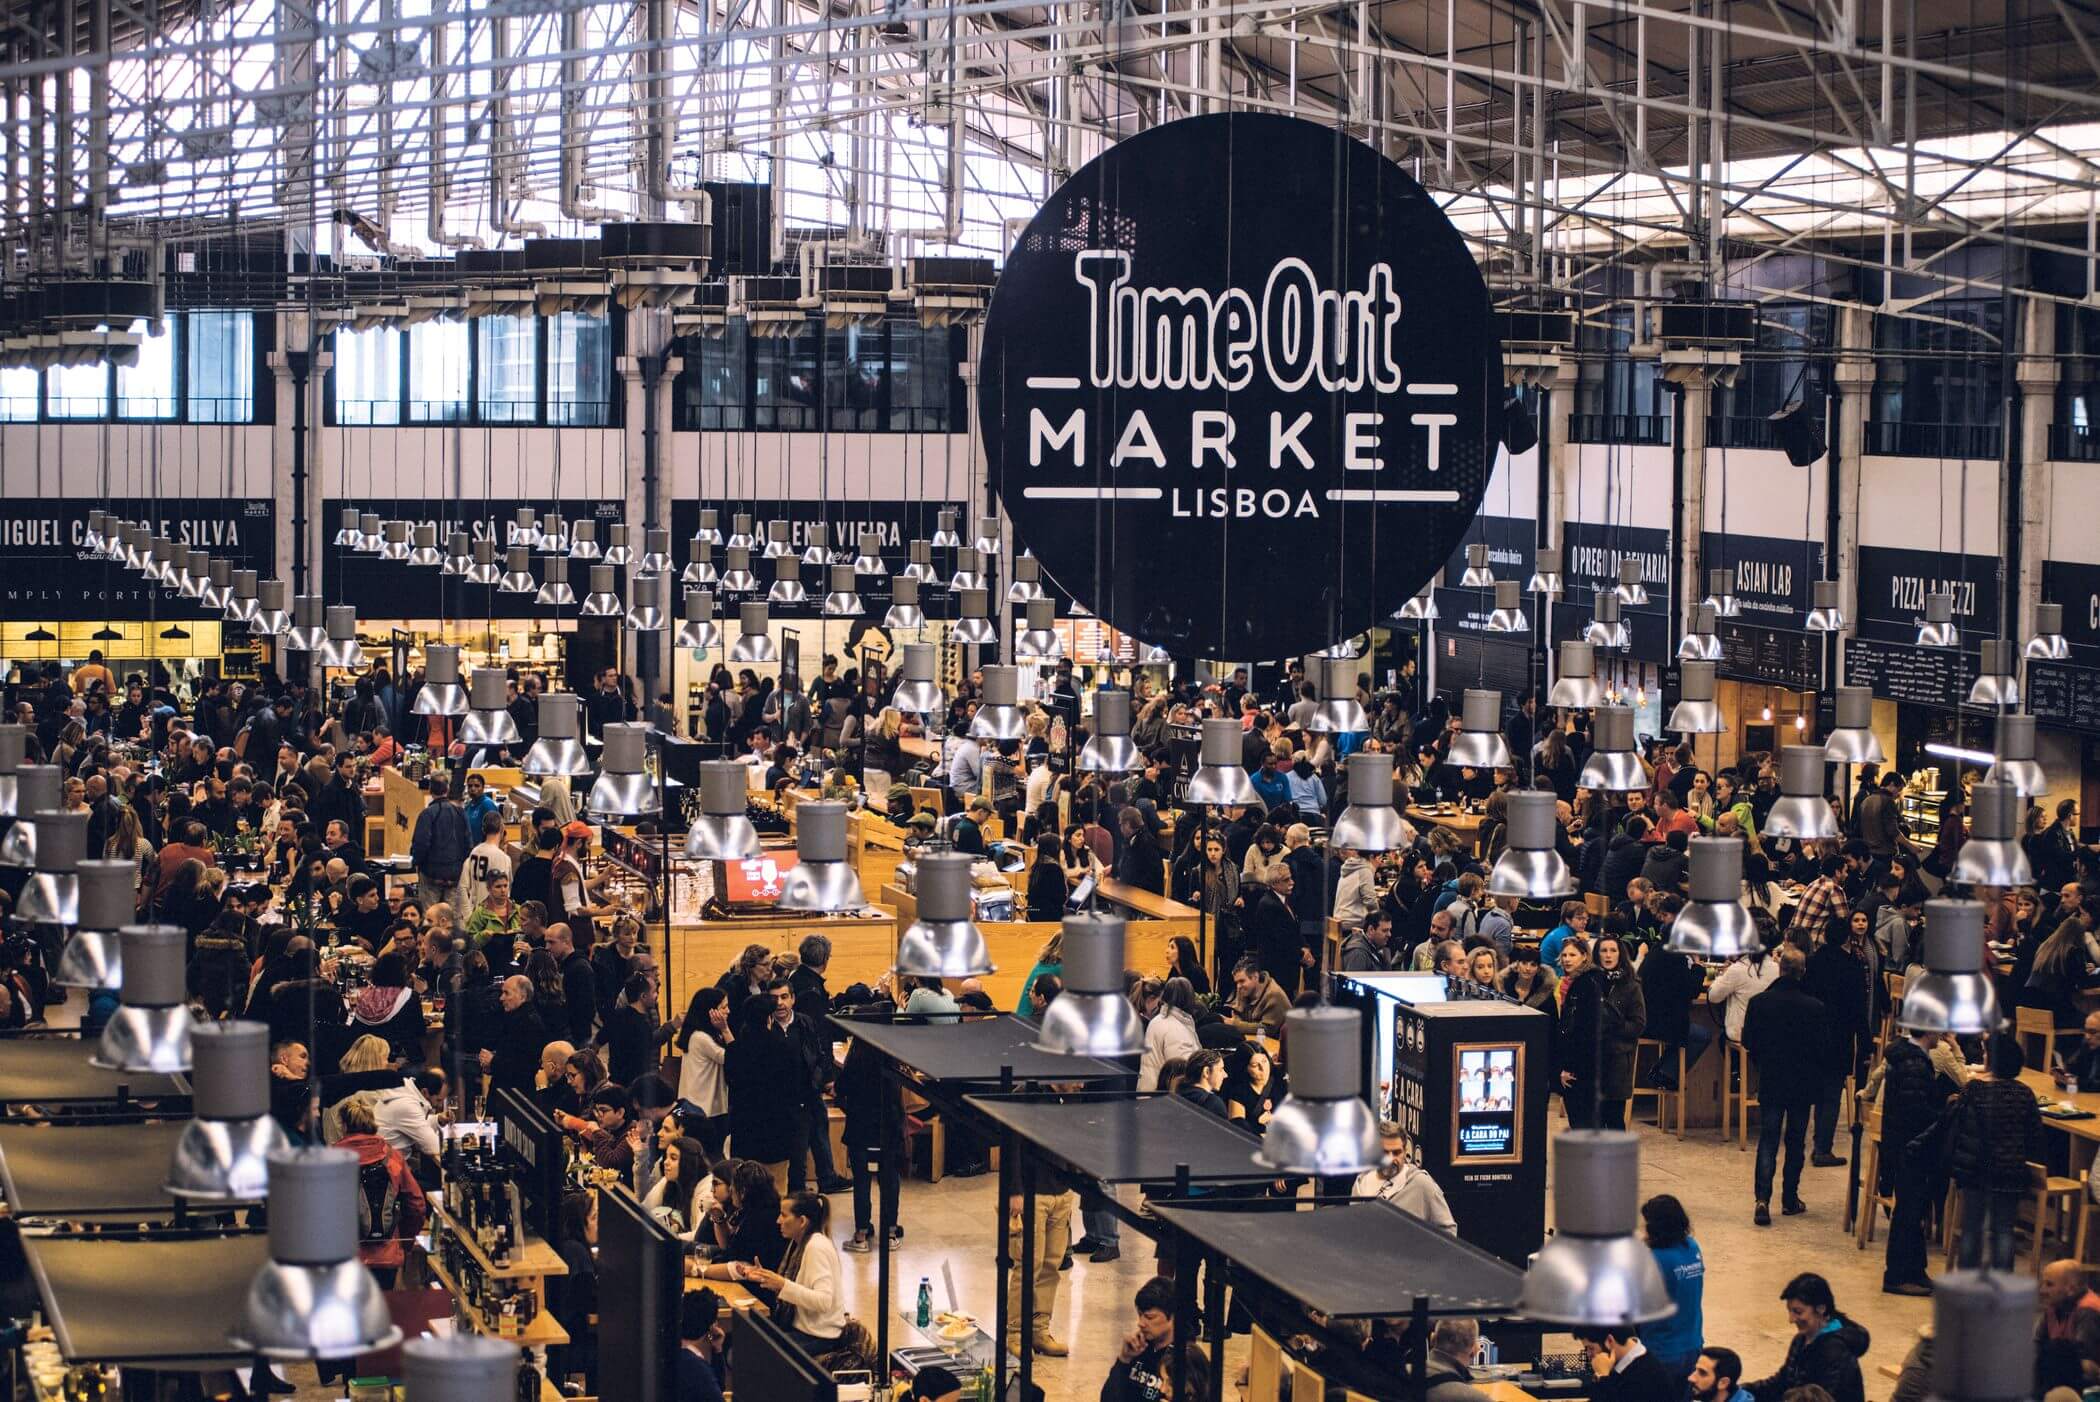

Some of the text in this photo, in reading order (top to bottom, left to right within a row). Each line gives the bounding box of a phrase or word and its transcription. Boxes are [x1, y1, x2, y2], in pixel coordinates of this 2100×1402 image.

[1028, 407, 1458, 471] MARKET
[1173, 488, 1320, 518] LISBOA
[0, 519, 62, 546] IGUEL
[472, 514, 497, 546] SÁ
[1572, 545, 1578, 574] O
[1580, 546, 1608, 577] PREGO
[1736, 559, 1792, 597] ASIAN LAB
[1892, 576, 1926, 611] PIZZA
